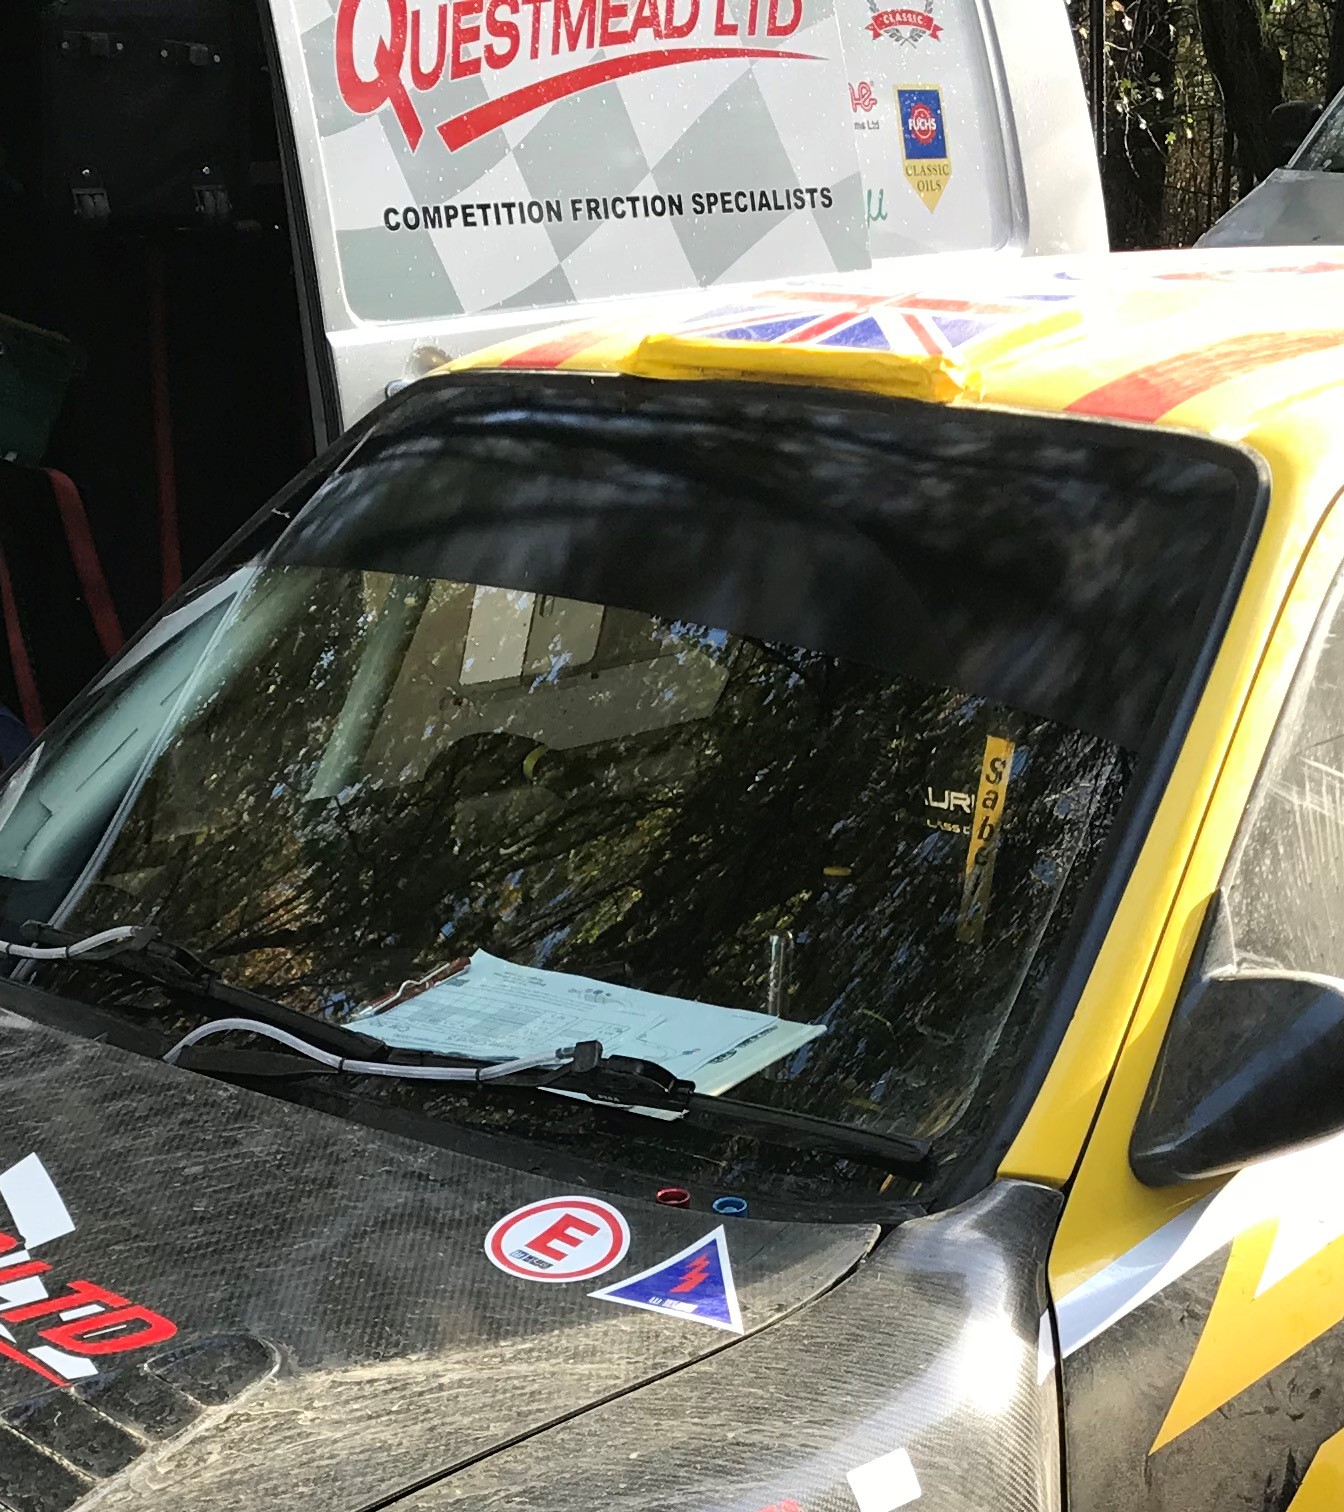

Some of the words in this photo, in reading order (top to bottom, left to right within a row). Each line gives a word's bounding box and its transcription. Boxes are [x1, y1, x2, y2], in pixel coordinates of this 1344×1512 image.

[882, 12, 924, 25] CLASSIC
[336, 0, 701, 154] QUESTMEAD
[714, 0, 803, 37] LTD
[908, 118, 936, 131] FUCHS
[905, 163, 950, 177] CLASSIC
[917, 180, 942, 192] OILS
[383, 199, 563, 232] COMPETITION
[571, 193, 684, 221] FRICTION
[691, 187, 834, 214] SPECIALISTS
[524, 1213, 601, 1262] E
